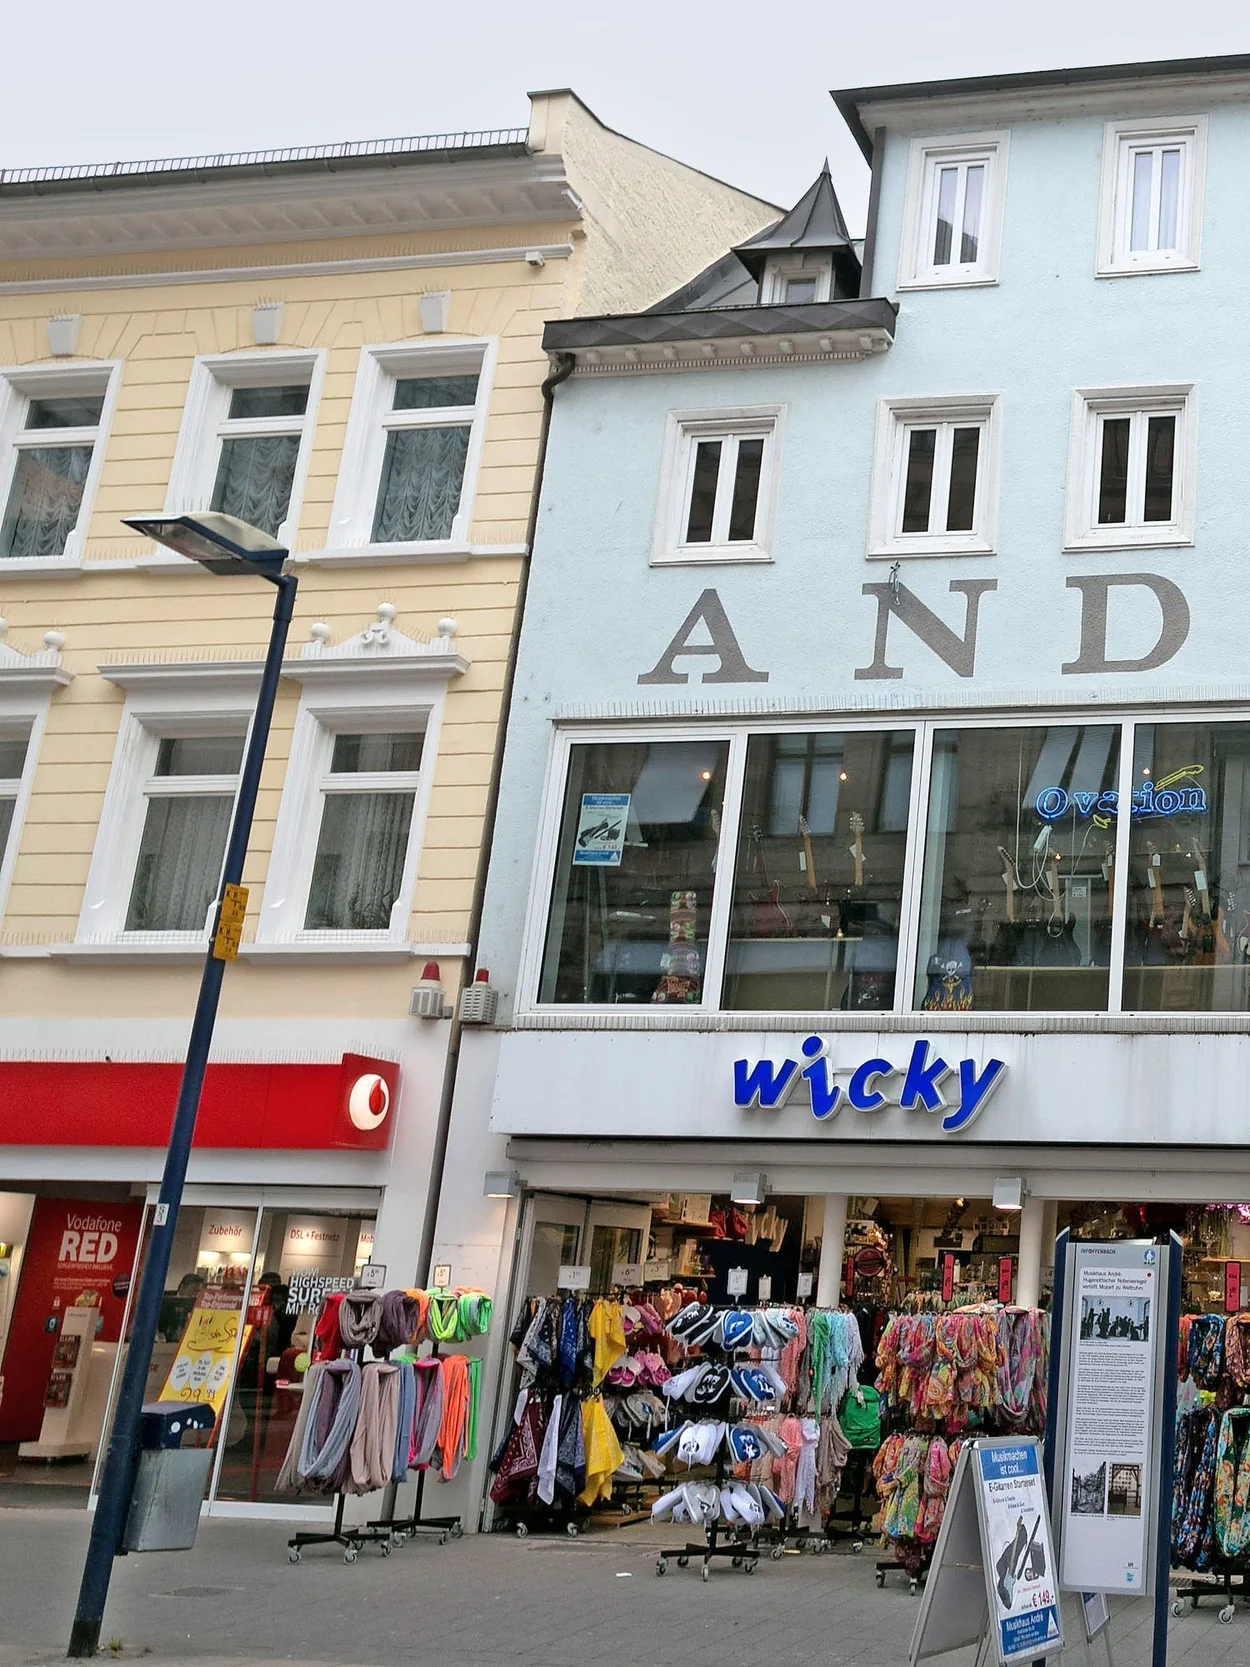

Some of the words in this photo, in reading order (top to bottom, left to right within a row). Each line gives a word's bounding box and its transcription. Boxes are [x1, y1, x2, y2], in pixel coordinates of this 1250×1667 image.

[1036, 781, 1207, 819] Ovation
[734, 1035, 1005, 1132] wicky
[67, 1213, 123, 1233] Vodafone
[208, 1225, 242, 1237] Zubehör
[290, 1229, 304, 1239] DSL
[311, 1231, 340, 1242] Festnetz
[58, 1230, 119, 1263] RED
[290, 1277, 355, 1288] HIGHSPEED
[286, 1303, 306, 1315] MIT
[991, 1450, 1027, 1463] Musikmachen
